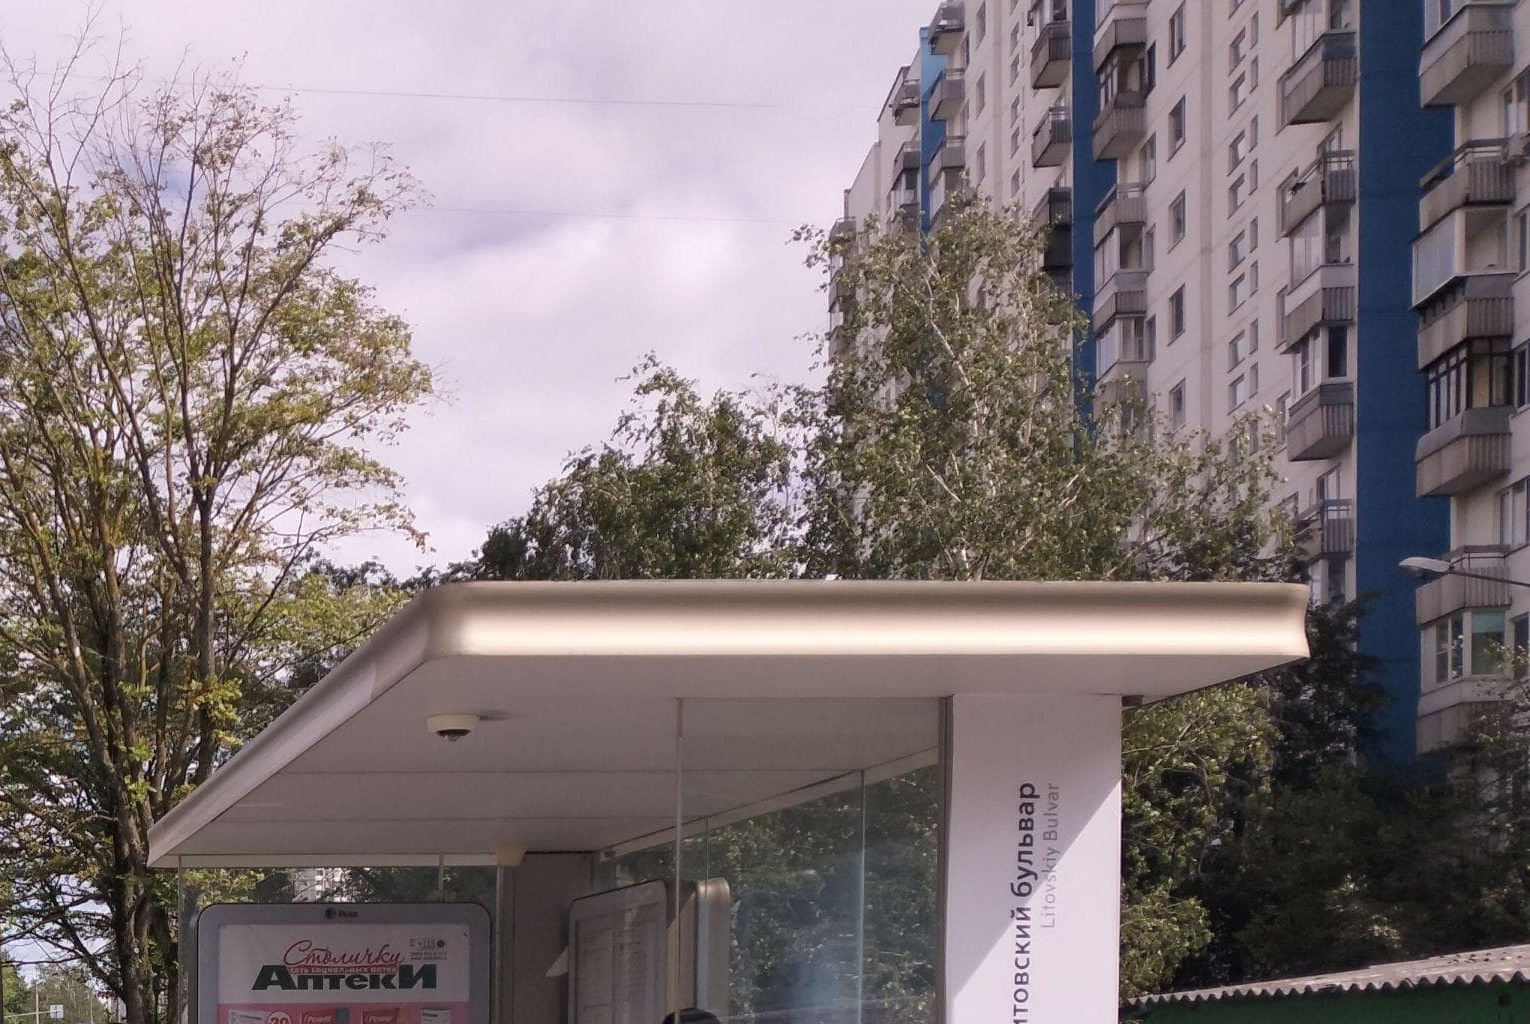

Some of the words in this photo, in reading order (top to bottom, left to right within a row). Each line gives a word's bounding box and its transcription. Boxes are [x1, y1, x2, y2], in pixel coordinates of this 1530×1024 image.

[1011, 782, 1040, 899] бульвар
[1043, 782, 1060, 841] Bulvar
[1041, 847, 1060, 929] Litovskiy
[282, 938, 405, 966] Столички
